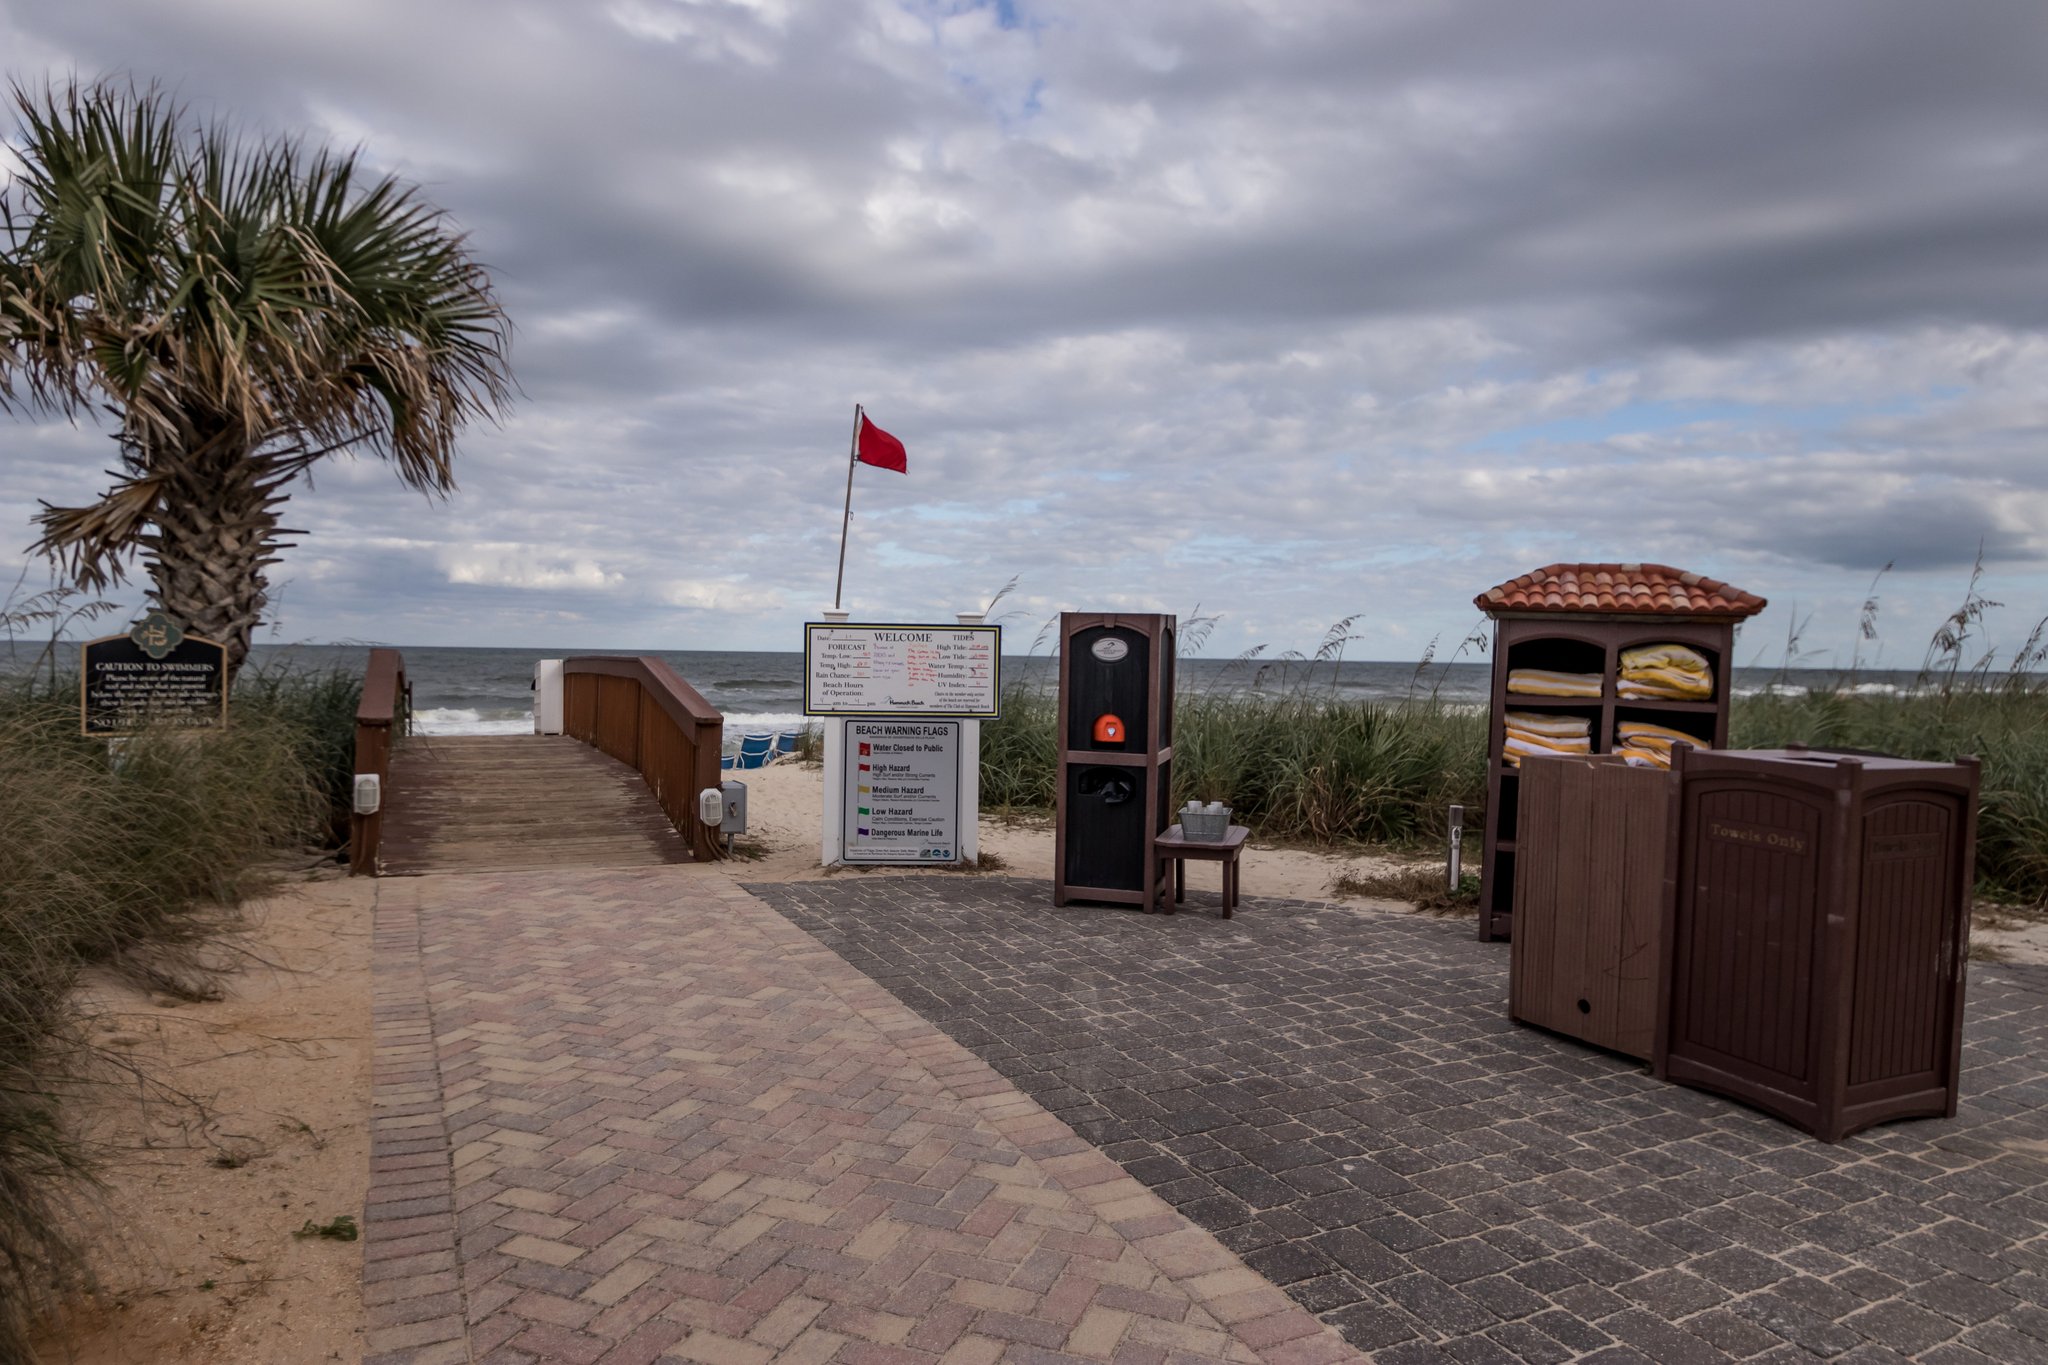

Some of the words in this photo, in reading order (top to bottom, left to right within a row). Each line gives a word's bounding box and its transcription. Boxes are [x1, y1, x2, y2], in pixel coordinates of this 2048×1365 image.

[874, 633, 932, 642] WELCOME
[96, 662, 144, 672] CAUTION
[147, 662, 160, 672] TO
[162, 662, 214, 672] SWIMMERS
[856, 726, 882, 736] BEACH
[885, 726, 920, 736] WARNING
[923, 726, 948, 736] FLAGS
[873, 744, 891, 752] Water
[893, 744, 914, 752] Closed
[916, 744, 922, 752] to
[924, 744, 943, 752] Public
[873, 764, 887, 772] High
[889, 764, 910, 772] Hazard
[872, 786, 899, 794] Medium
[902, 786, 924, 794] Hazard
[872, 828, 905, 837] Dangerous
[907, 828, 929, 836] Marine
[931, 828, 943, 836] Life
[1711, 823, 1760, 841] Towels
[1767, 833, 1805, 852] Only
